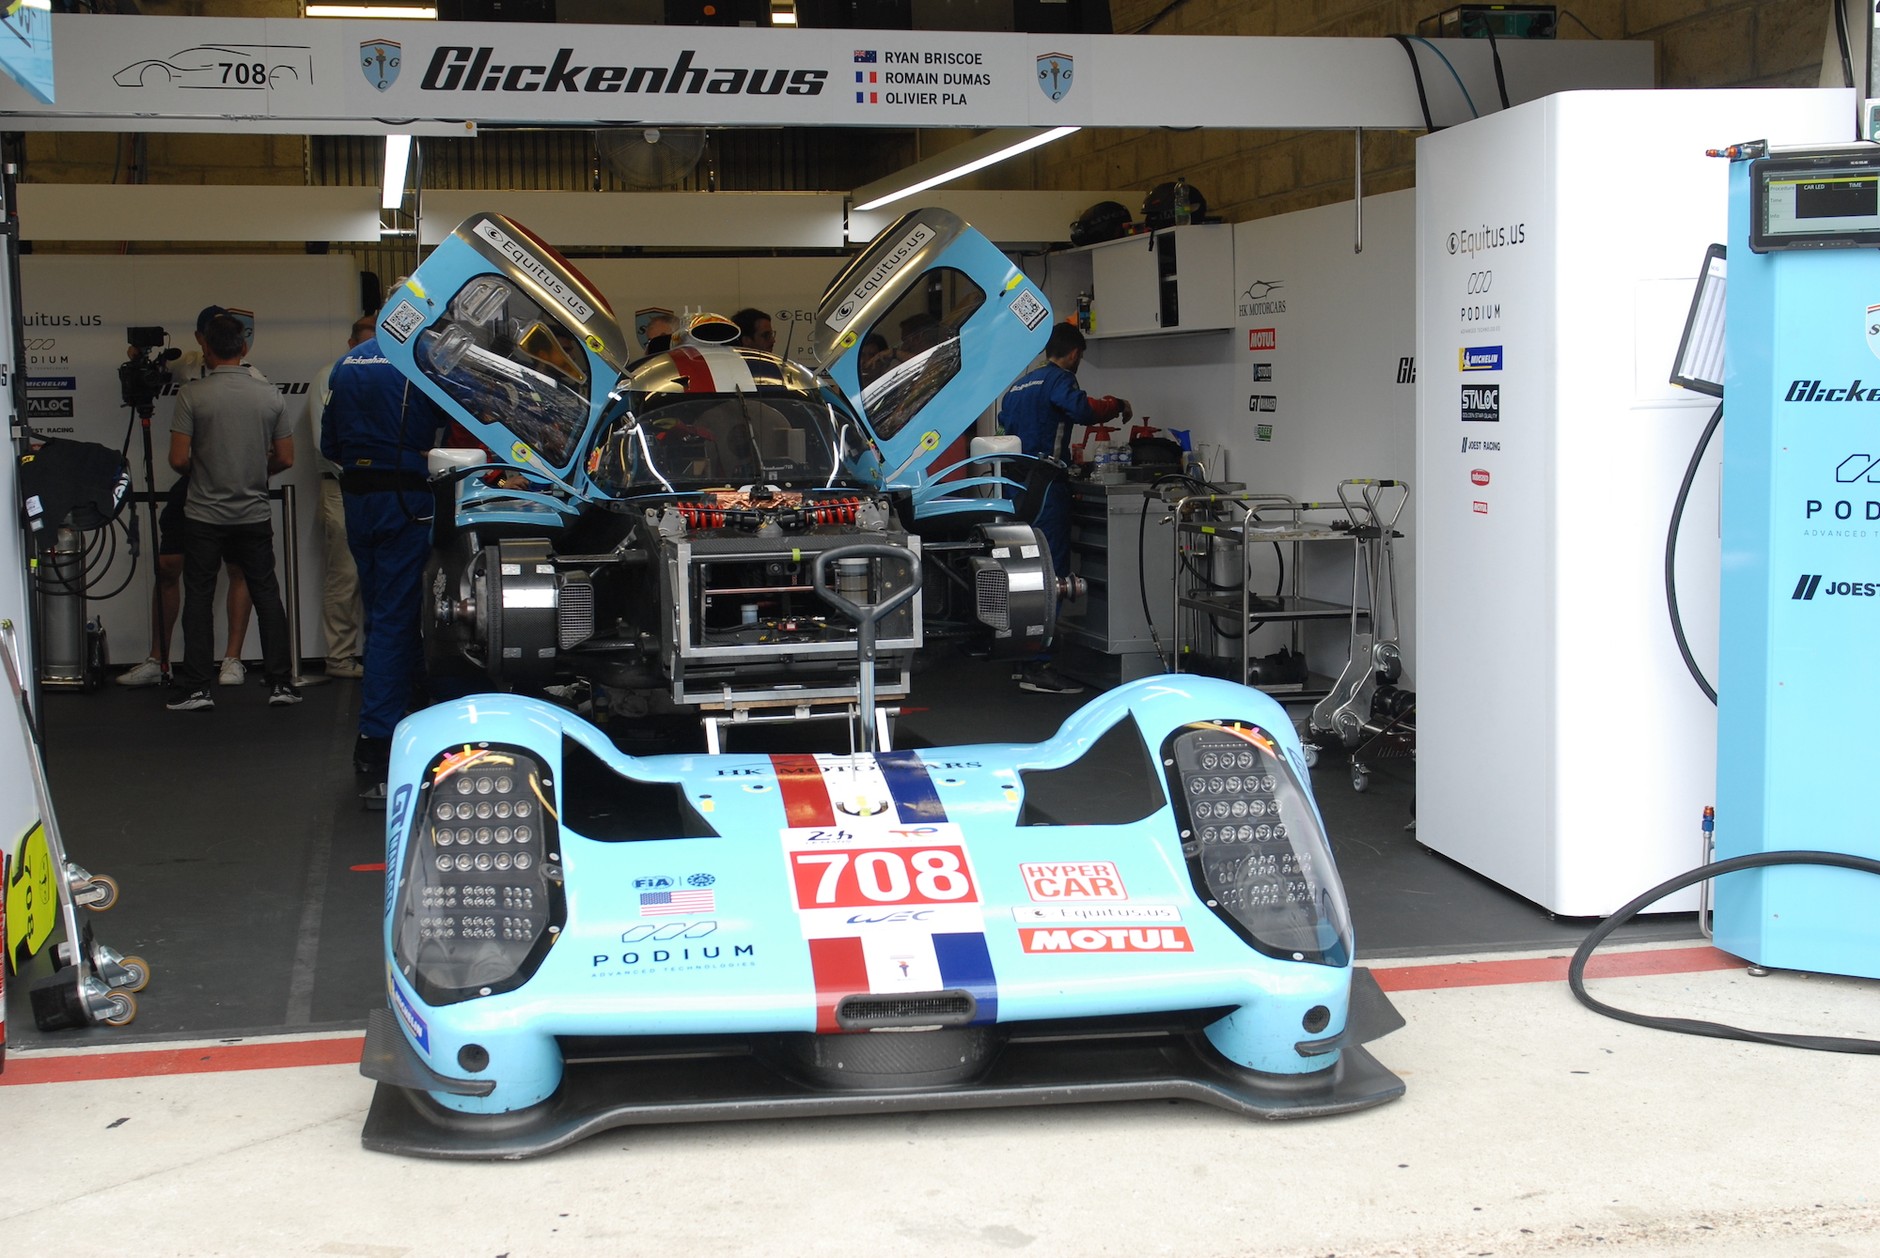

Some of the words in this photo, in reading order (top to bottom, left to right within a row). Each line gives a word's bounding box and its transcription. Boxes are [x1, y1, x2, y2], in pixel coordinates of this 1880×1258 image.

[885, 51, 919, 64] RYAN
[924, 53, 982, 65] BRISCOE
[218, 62, 266, 85] 708
[420, 46, 829, 96] Glickenhaus
[885, 72, 938, 85] ROMAIN
[943, 74, 991, 86] DUMAS
[885, 92, 937, 105] OLIVIER
[942, 94, 967, 105] PLA
[1461, 223, 1525, 259] Equitus.us
[854, 230, 925, 299] Equitus.us
[502, 240, 587, 316] Equitus.us
[1239, 304, 1249, 317] HK
[1249, 300, 1286, 316] MOTORCARS
[1461, 304, 1500, 321] PODIUM
[23, 312, 102, 326] uitus.us
[1251, 331, 1274, 348] MOTUL
[1471, 354, 1498, 364] MICHELIN
[28, 400, 69, 411] TALOC
[1462, 390, 1498, 409] STALOC
[1468, 441, 1481, 450] JOEST
[1483, 442, 1501, 451] RACING
[1804, 529, 1866, 537] ADVANCED
[1826, 582, 1880, 596] JOES
[718, 768, 765, 776] HK
[796, 850, 970, 904] 708
[1028, 865, 1110, 877] HYPER
[1034, 877, 1118, 897] CAR
[1061, 907, 1170, 919] Equitus.us
[1030, 929, 1184, 950] MOTUL
[593, 944, 754, 967] PODIUM
